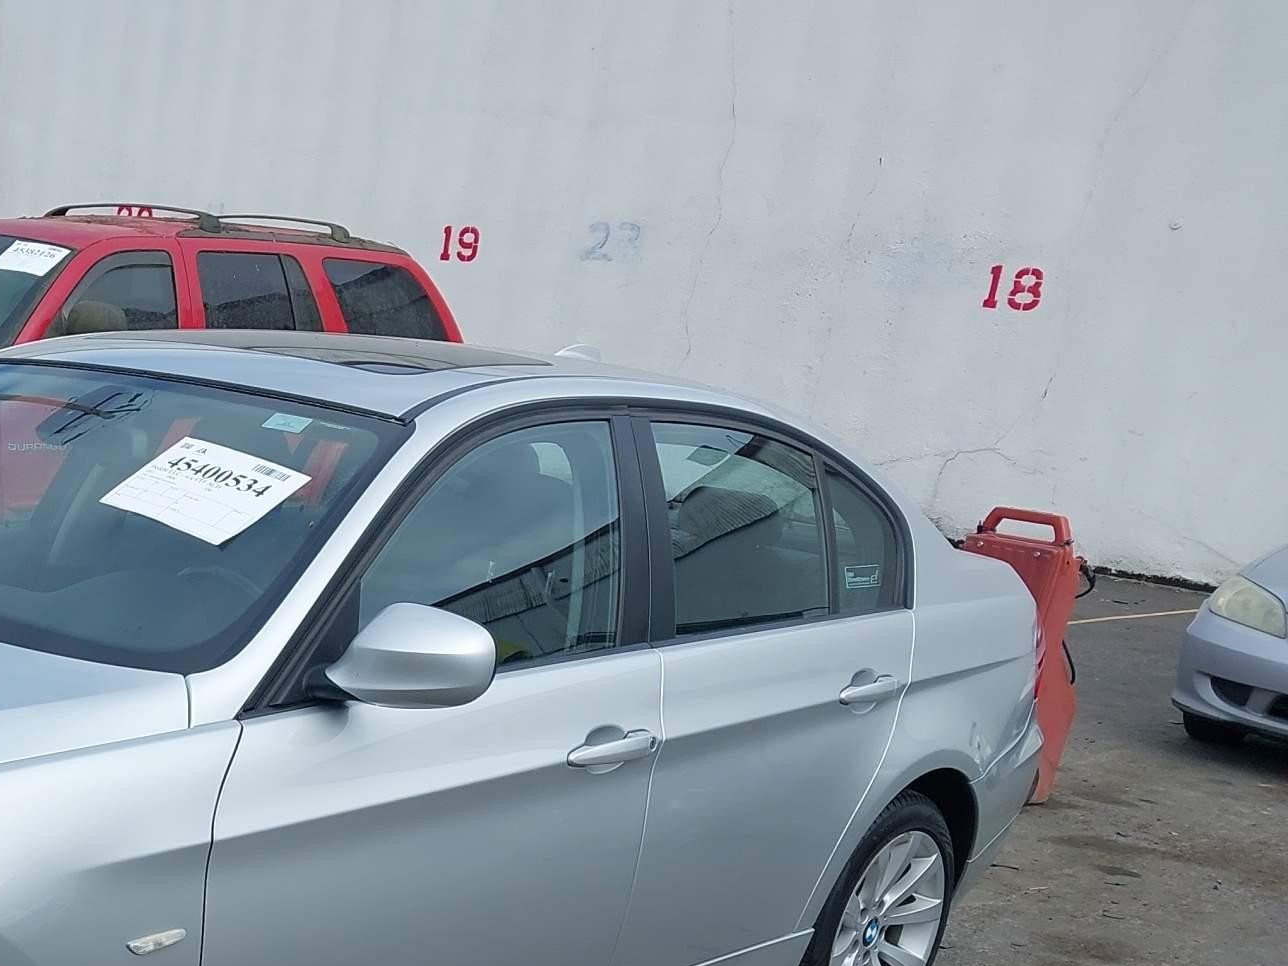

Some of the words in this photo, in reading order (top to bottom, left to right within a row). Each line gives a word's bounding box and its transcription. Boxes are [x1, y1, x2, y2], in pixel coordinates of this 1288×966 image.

[439, 225, 481, 263] 19
[981, 264, 1045, 312] 18
[166, 456, 273, 498] 45400534
